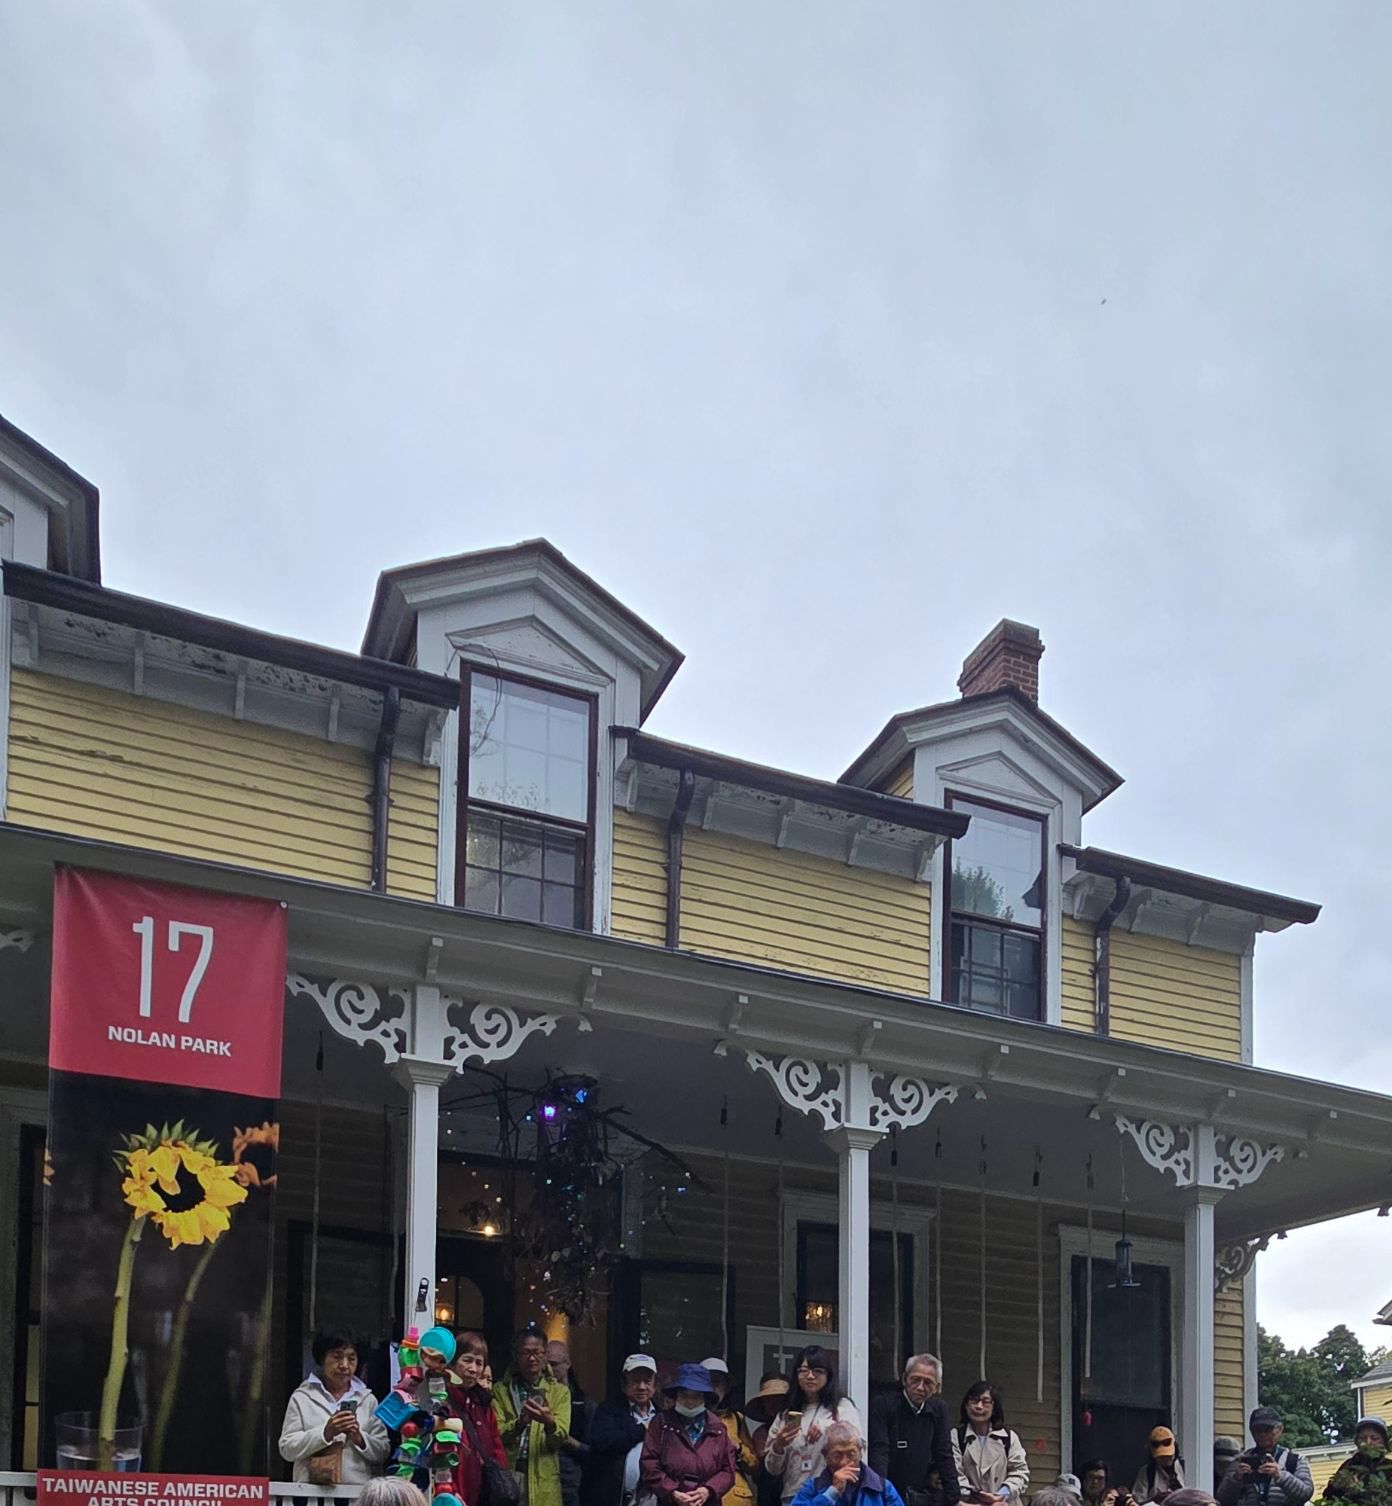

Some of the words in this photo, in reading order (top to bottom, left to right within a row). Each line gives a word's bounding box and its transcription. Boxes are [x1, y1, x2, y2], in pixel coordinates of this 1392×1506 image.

[133, 916, 213, 1023] 17
[108, 1025, 176, 1049] NOLAN
[180, 1035, 232, 1057] PARK
[42, 1477, 159, 1497] TAIWANESE
[163, 1482, 263, 1499] AMERICAN
